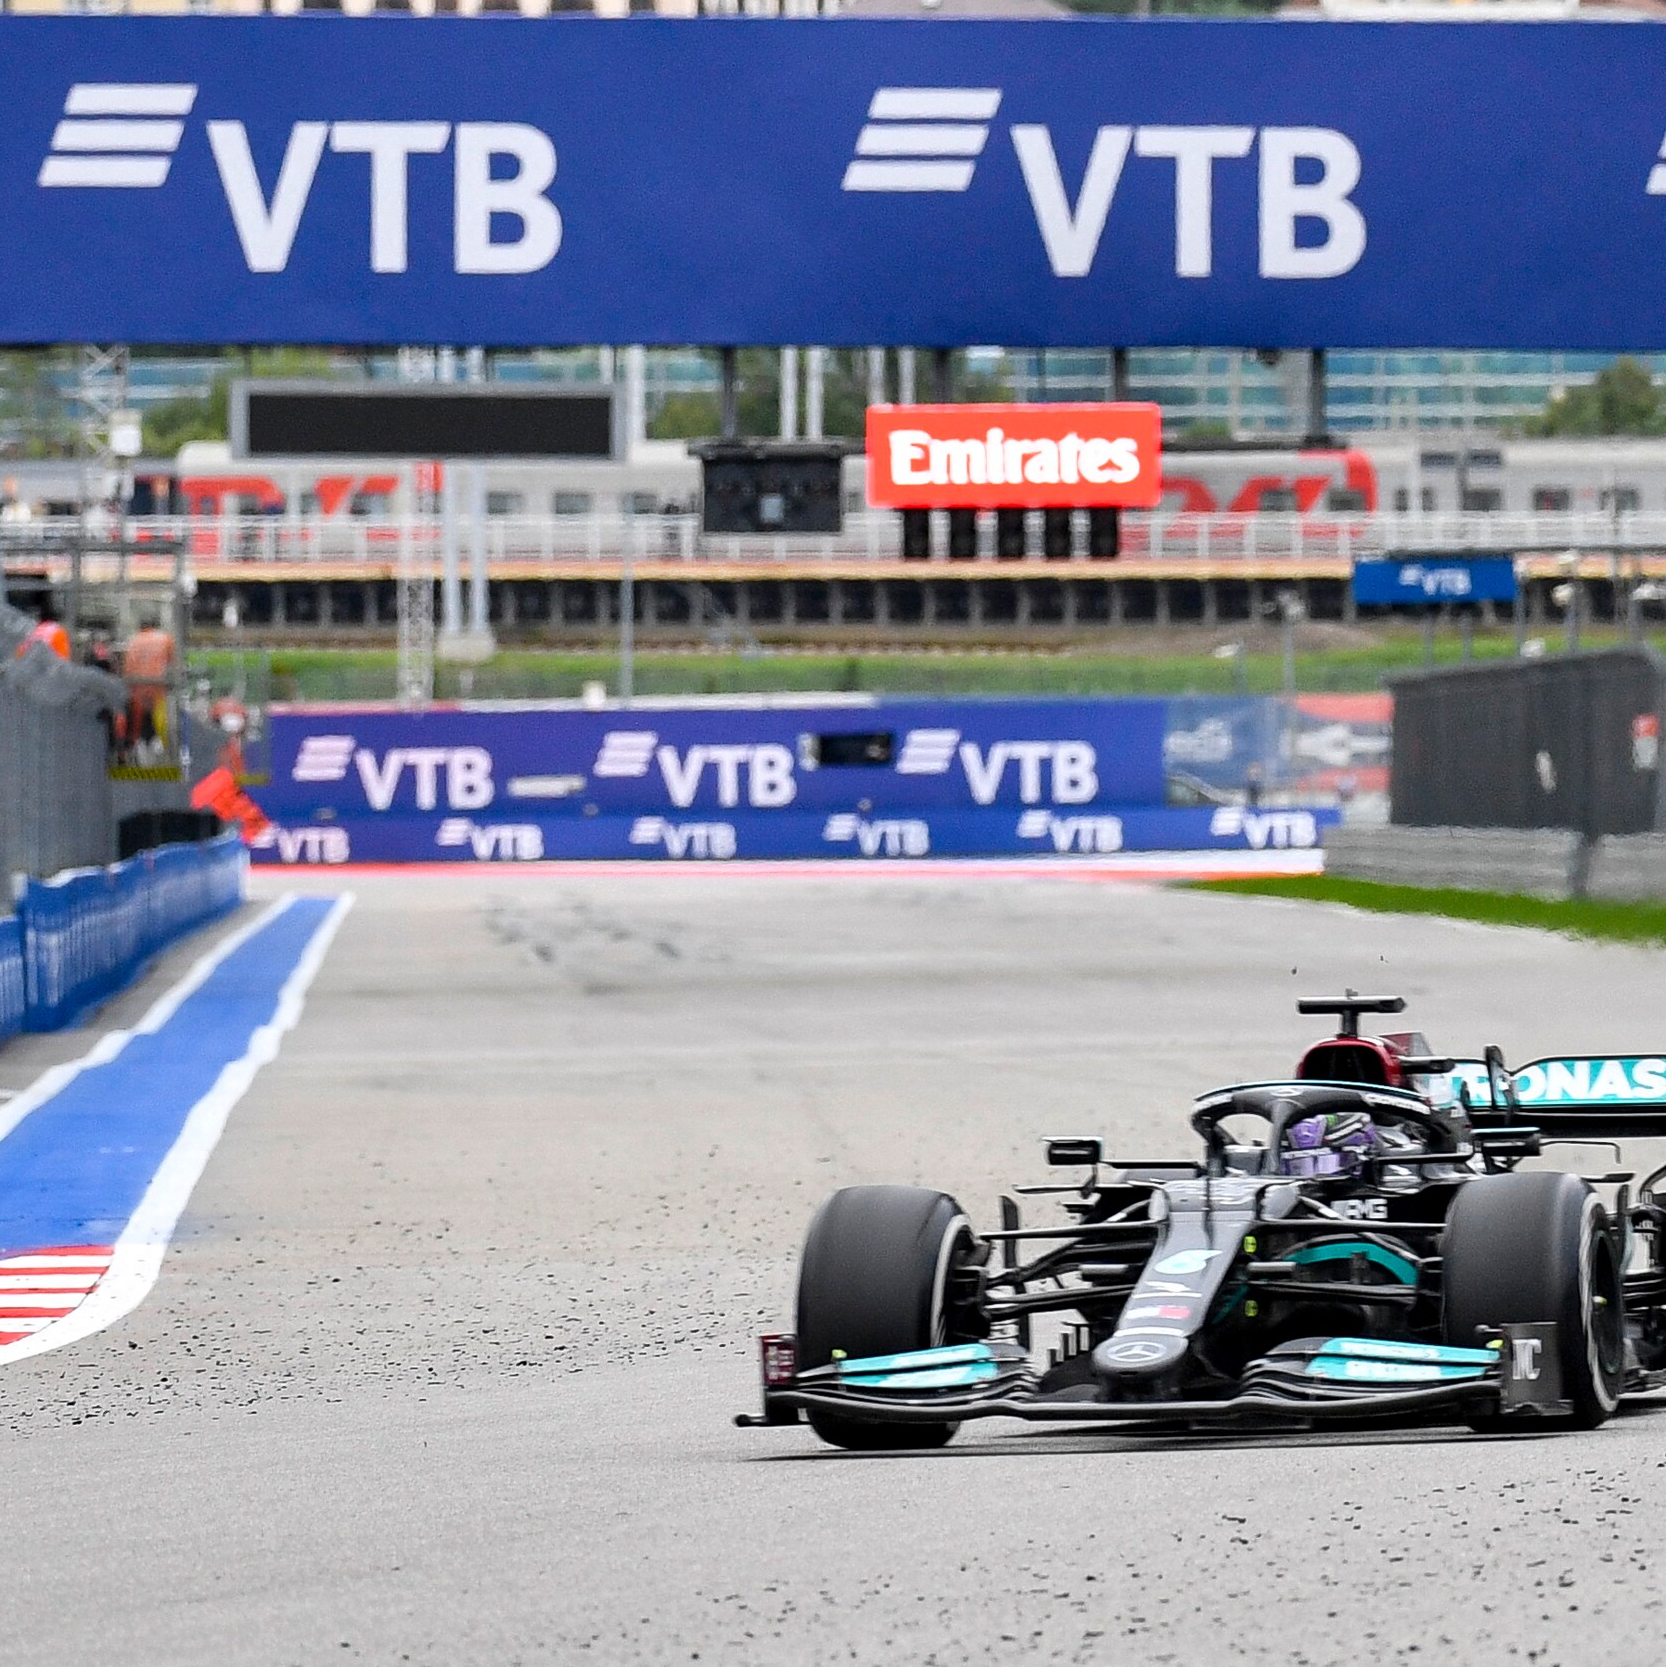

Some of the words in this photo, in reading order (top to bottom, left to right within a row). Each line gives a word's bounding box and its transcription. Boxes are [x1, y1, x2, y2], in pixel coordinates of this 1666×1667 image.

[206, 121, 564, 274] VTB
[1010, 125, 1367, 278] VTB
[888, 428, 1141, 485] Emirates
[355, 745, 495, 810] VTB
[657, 744, 797, 807] VTB
[959, 740, 1099, 804] VTB
[276, 825, 351, 864] VTB
[470, 823, 544, 862] VTB
[663, 822, 737, 860] VTB
[858, 819, 930, 856] VTB
[1051, 815, 1123, 853] VTB
[1243, 810, 1317, 849] VTB
